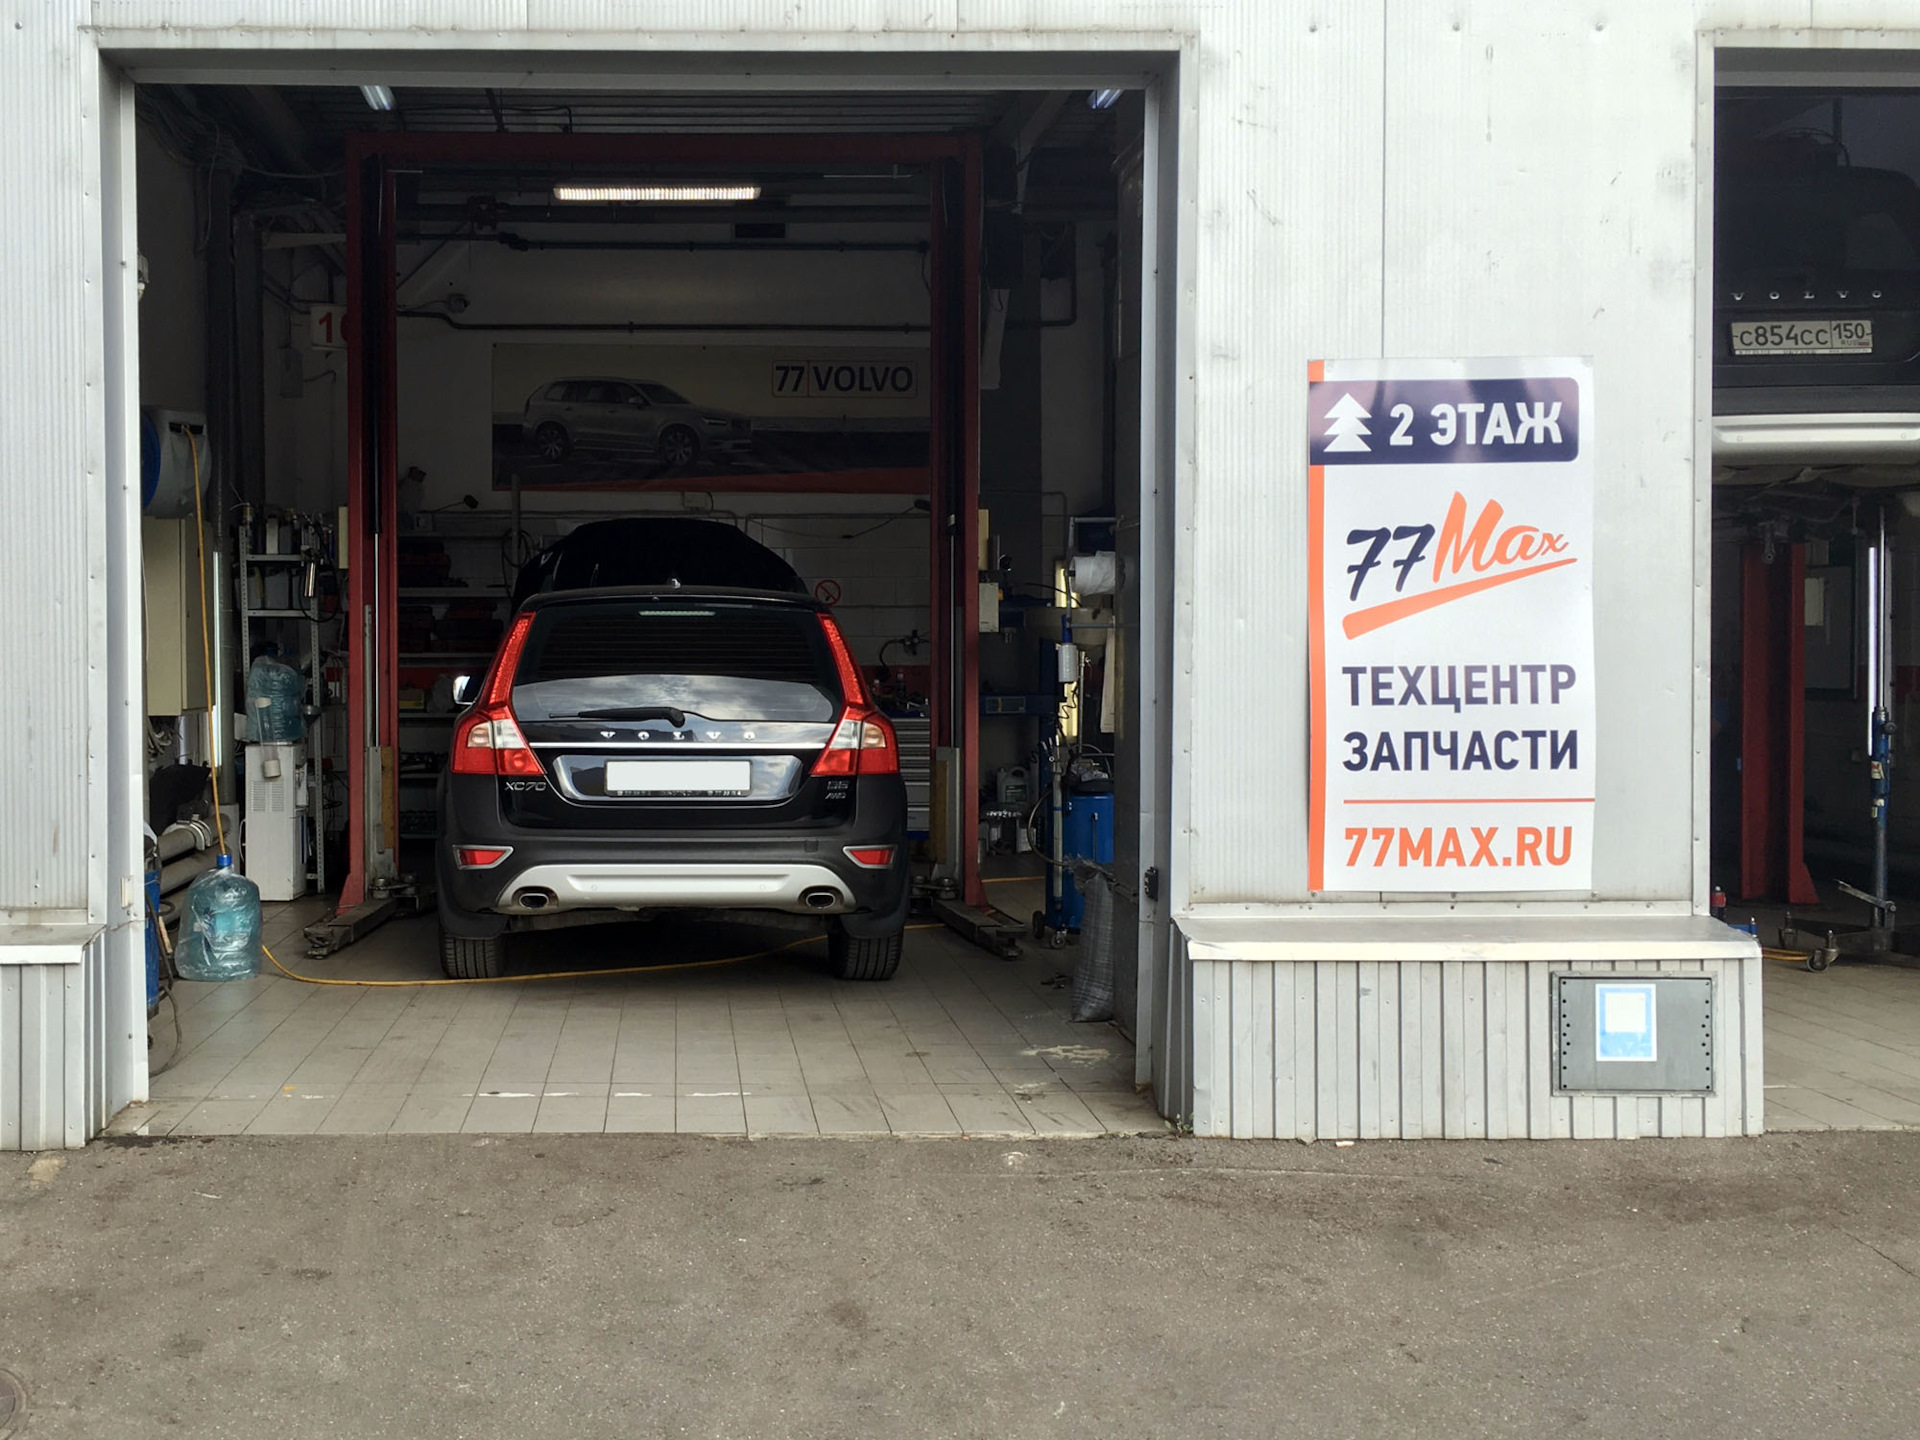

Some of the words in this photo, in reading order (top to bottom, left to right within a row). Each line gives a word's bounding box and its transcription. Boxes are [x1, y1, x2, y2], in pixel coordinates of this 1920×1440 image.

[1731, 290, 1882, 301] VOLVO
[1833, 322, 1866, 340] 150
[775, 365, 805, 392] 77
[813, 365, 913, 392] VOLVO
[1389, 402, 1414, 446] 2
[1429, 401, 1563, 446] ЭТАЖ
[1341, 664, 1577, 714] ТЕХЦЕНТР
[600, 731, 756, 741] VOLVO
[1342, 729, 1578, 772] ЗАПЧАСТИ
[504, 781, 547, 792] XC70
[1344, 826, 1573, 868] 77MAX.RU
